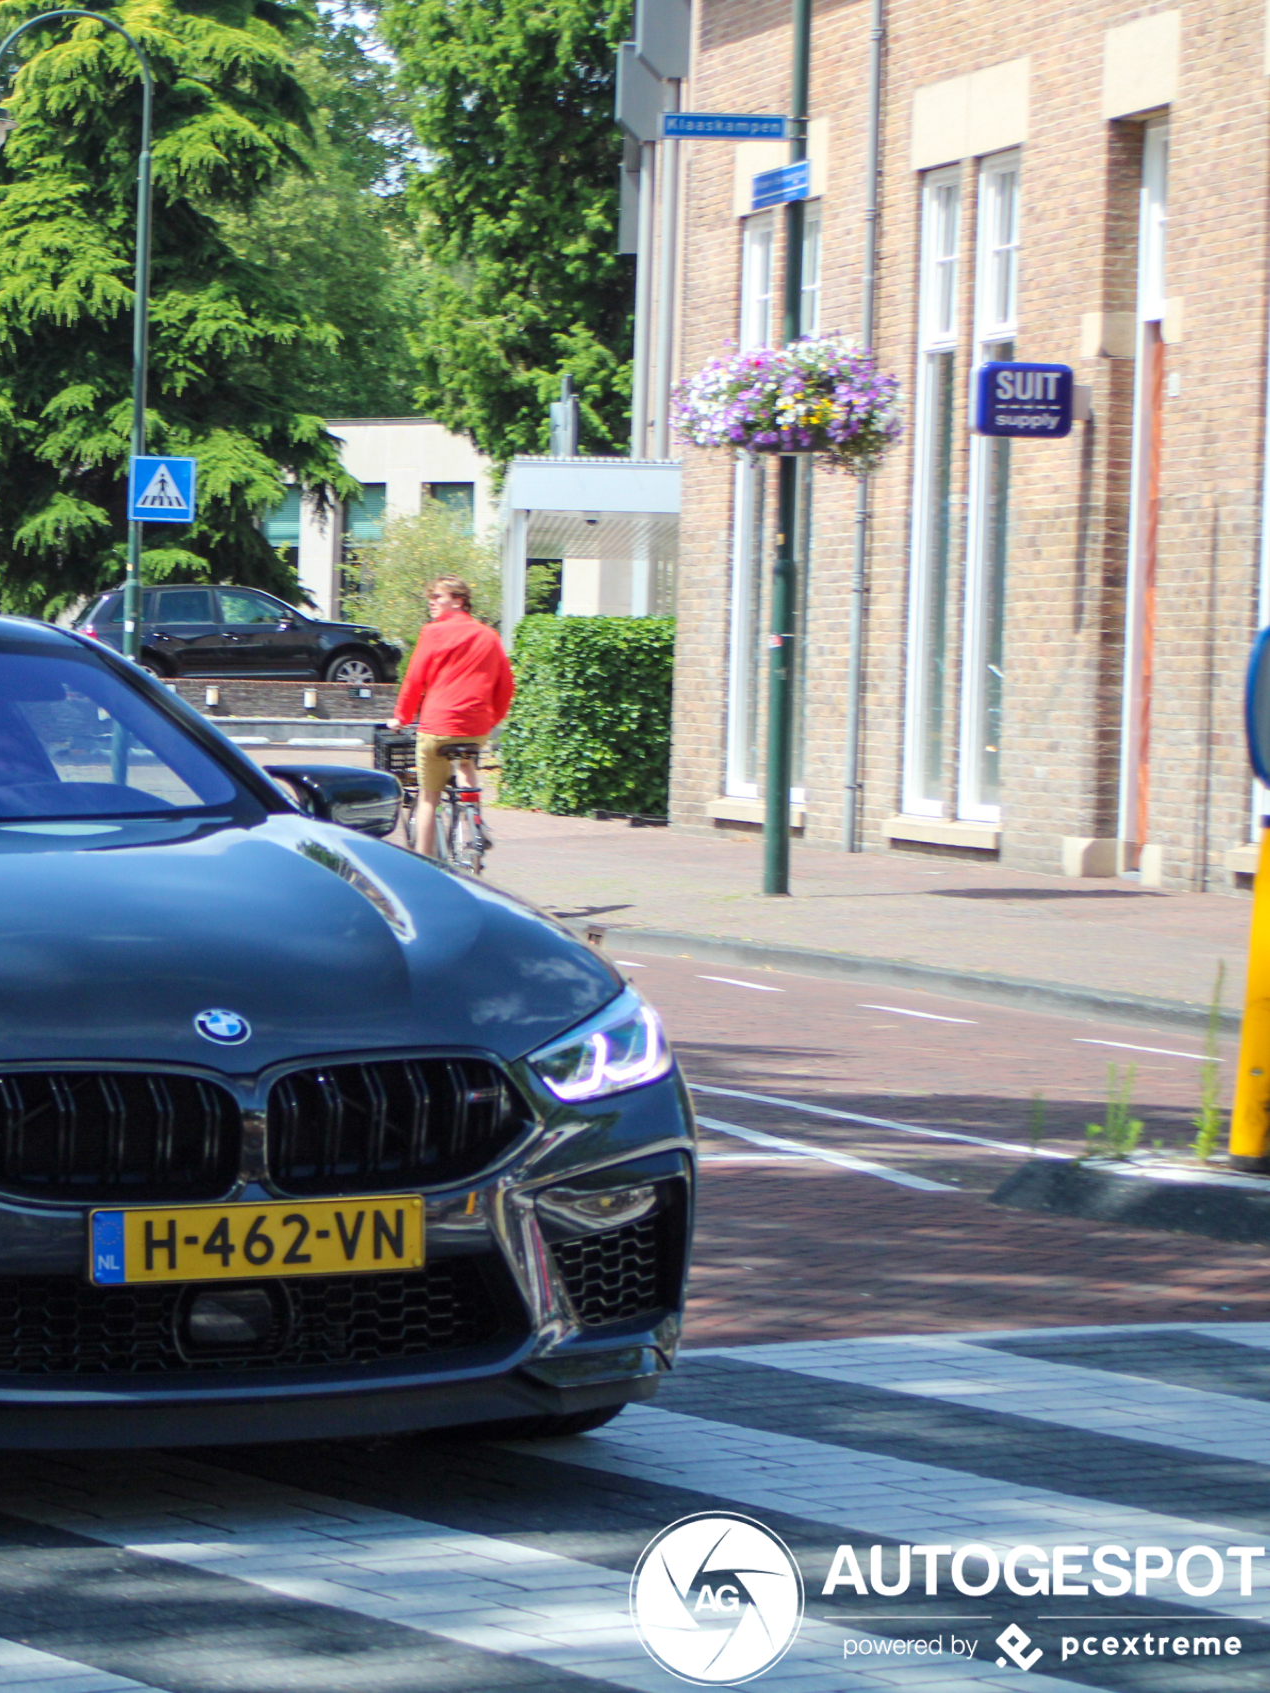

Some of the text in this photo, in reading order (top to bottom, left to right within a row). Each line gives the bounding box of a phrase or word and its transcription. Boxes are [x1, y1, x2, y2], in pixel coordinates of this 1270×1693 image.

[666, 117, 781, 135] Klaaskampen
[995, 370, 1062, 400] SUIT
[994, 413, 1061, 430] supply
[143, 1208, 405, 1271] H-462-VN
[96, 1253, 121, 1271] NL
